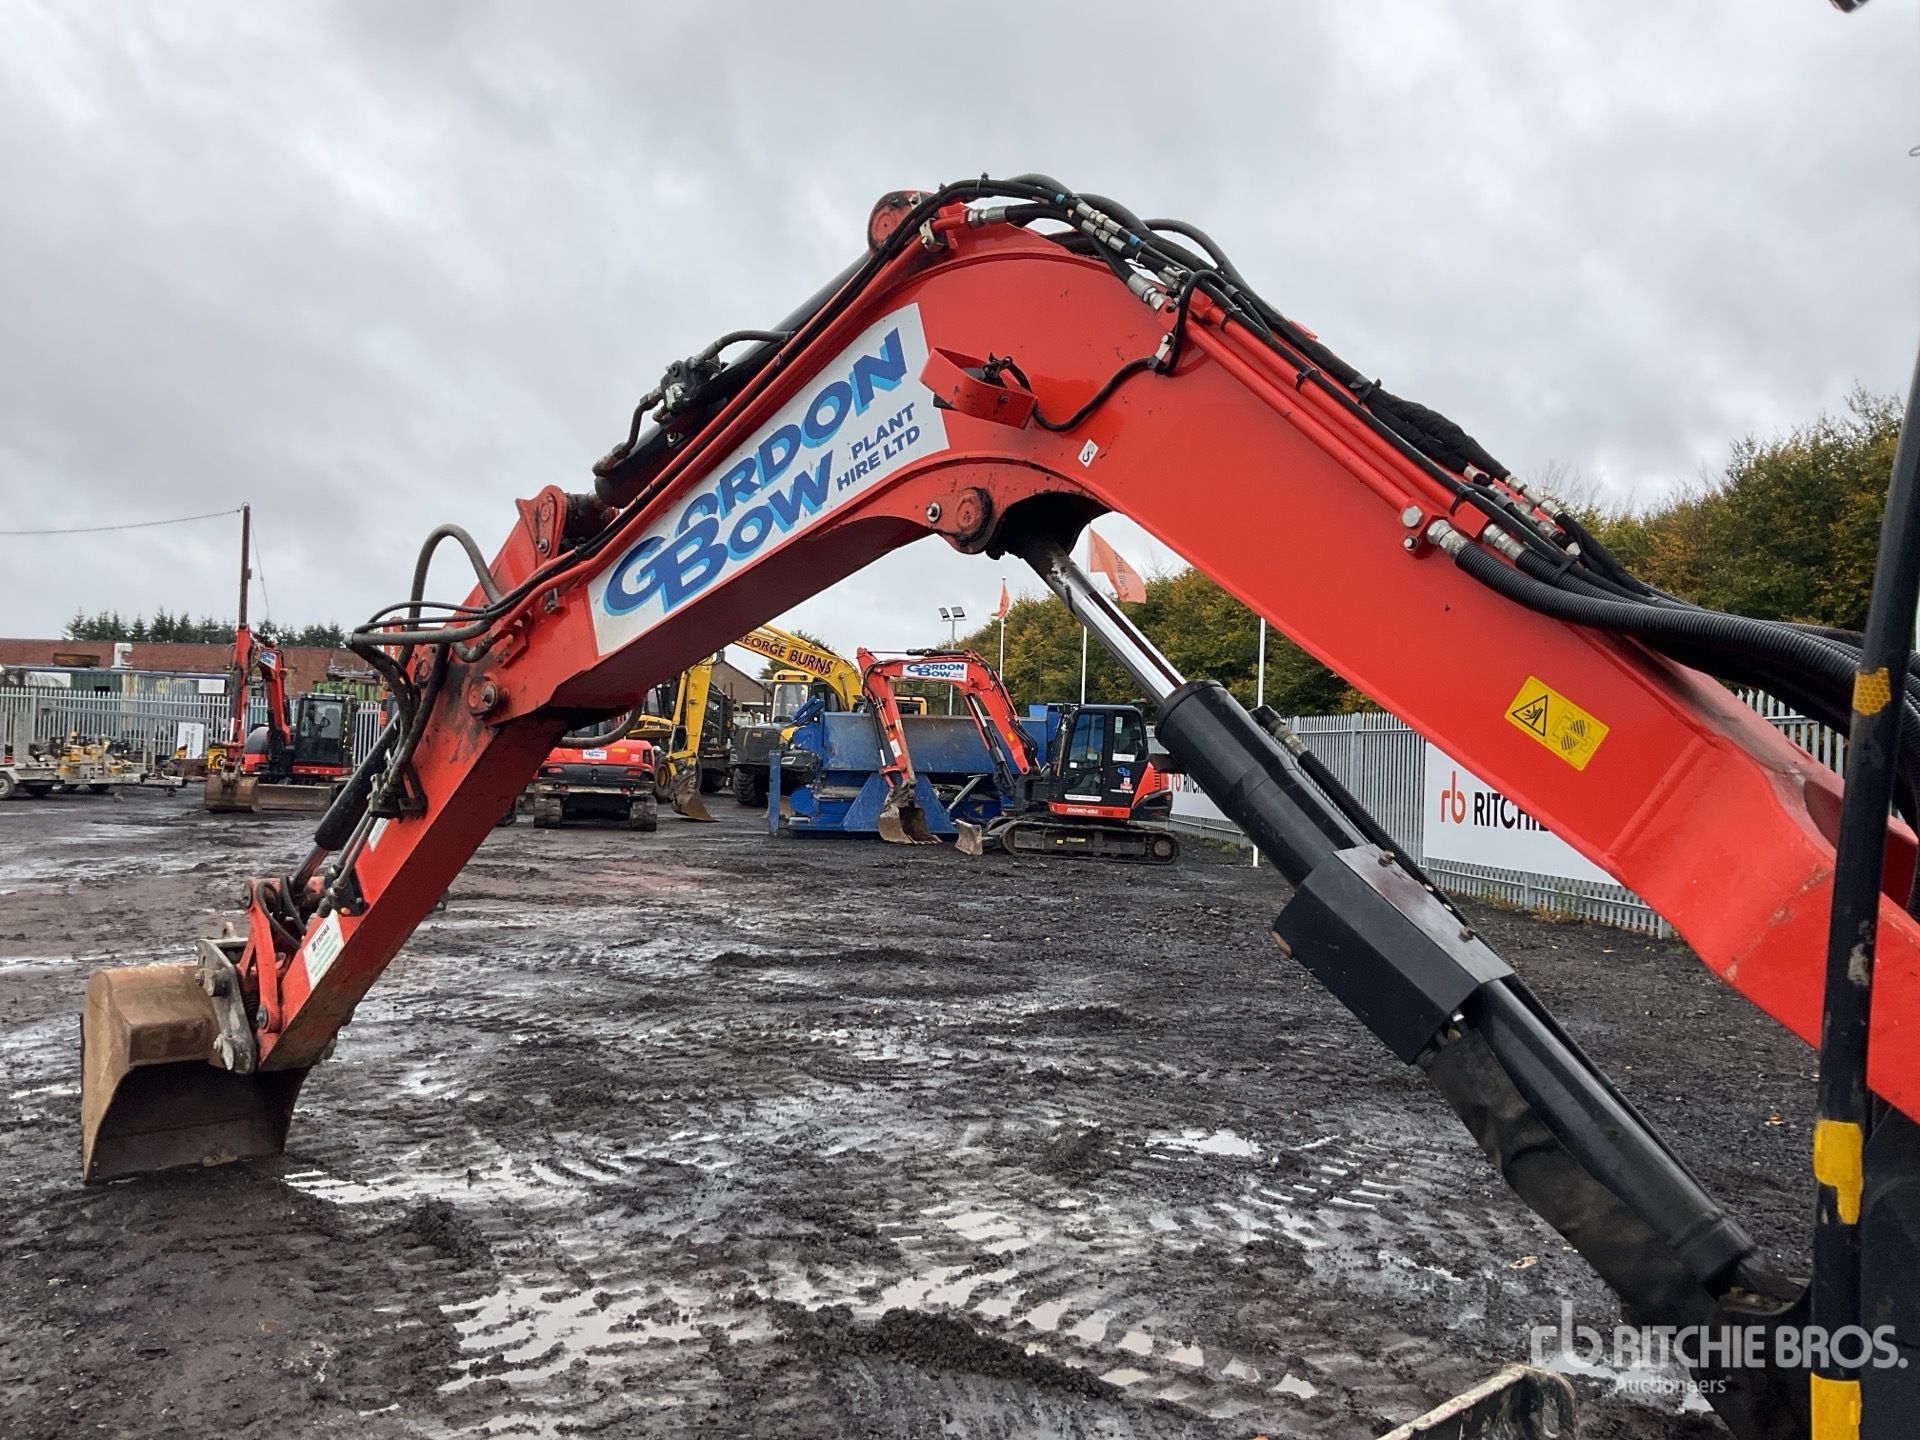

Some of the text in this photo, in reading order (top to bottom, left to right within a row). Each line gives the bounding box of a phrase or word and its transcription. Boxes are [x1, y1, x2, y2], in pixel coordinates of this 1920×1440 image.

[836, 426, 920, 491] HIRE LTD
[851, 402, 915, 460] PLANT
[603, 327, 907, 616] GORDON
[655, 450, 833, 613] BOW
[787, 649, 833, 676] BURNS
